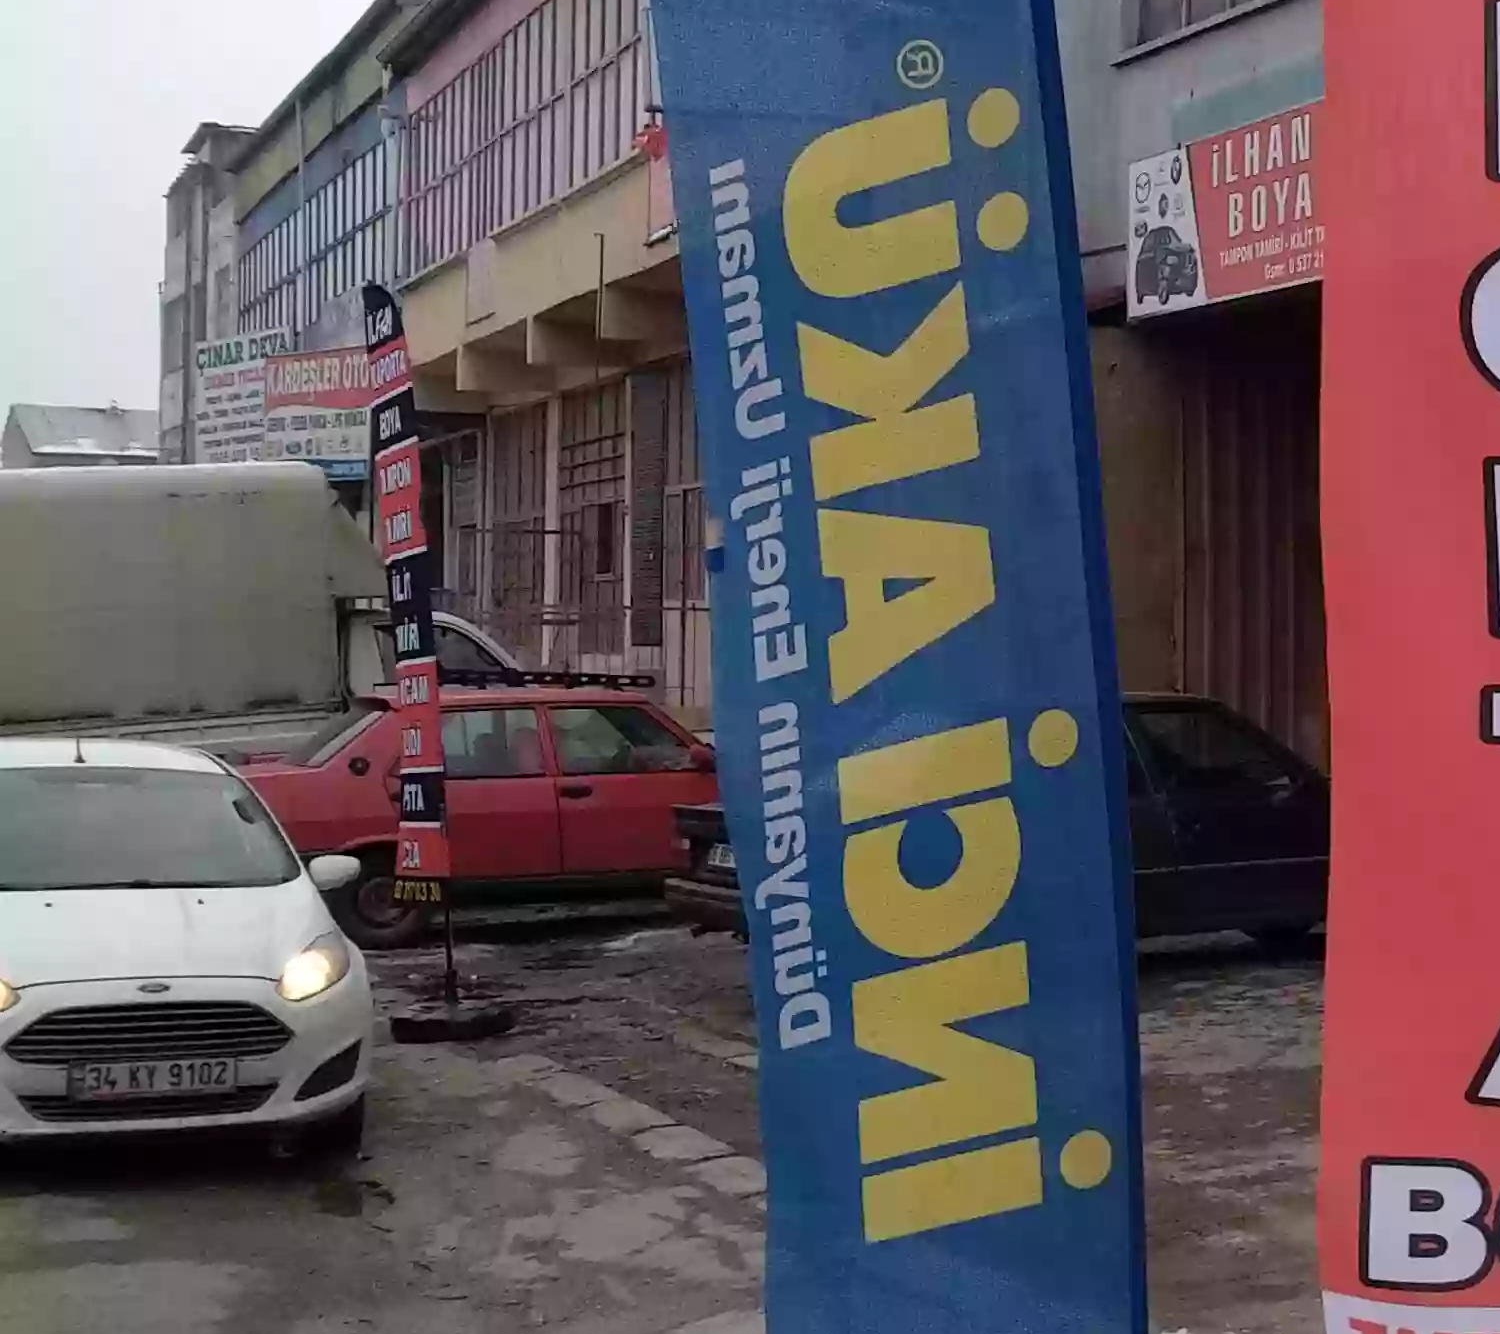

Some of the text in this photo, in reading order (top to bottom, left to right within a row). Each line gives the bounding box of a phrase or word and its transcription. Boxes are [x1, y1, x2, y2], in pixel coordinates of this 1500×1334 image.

[1212, 113, 1311, 188] İLHAN
[1228, 171, 1312, 238] BOYA
[1220, 242, 1253, 269] TAMPON
[343, 353, 370, 390] OTO
[87, 1061, 228, 1092] 34 KY 9102
